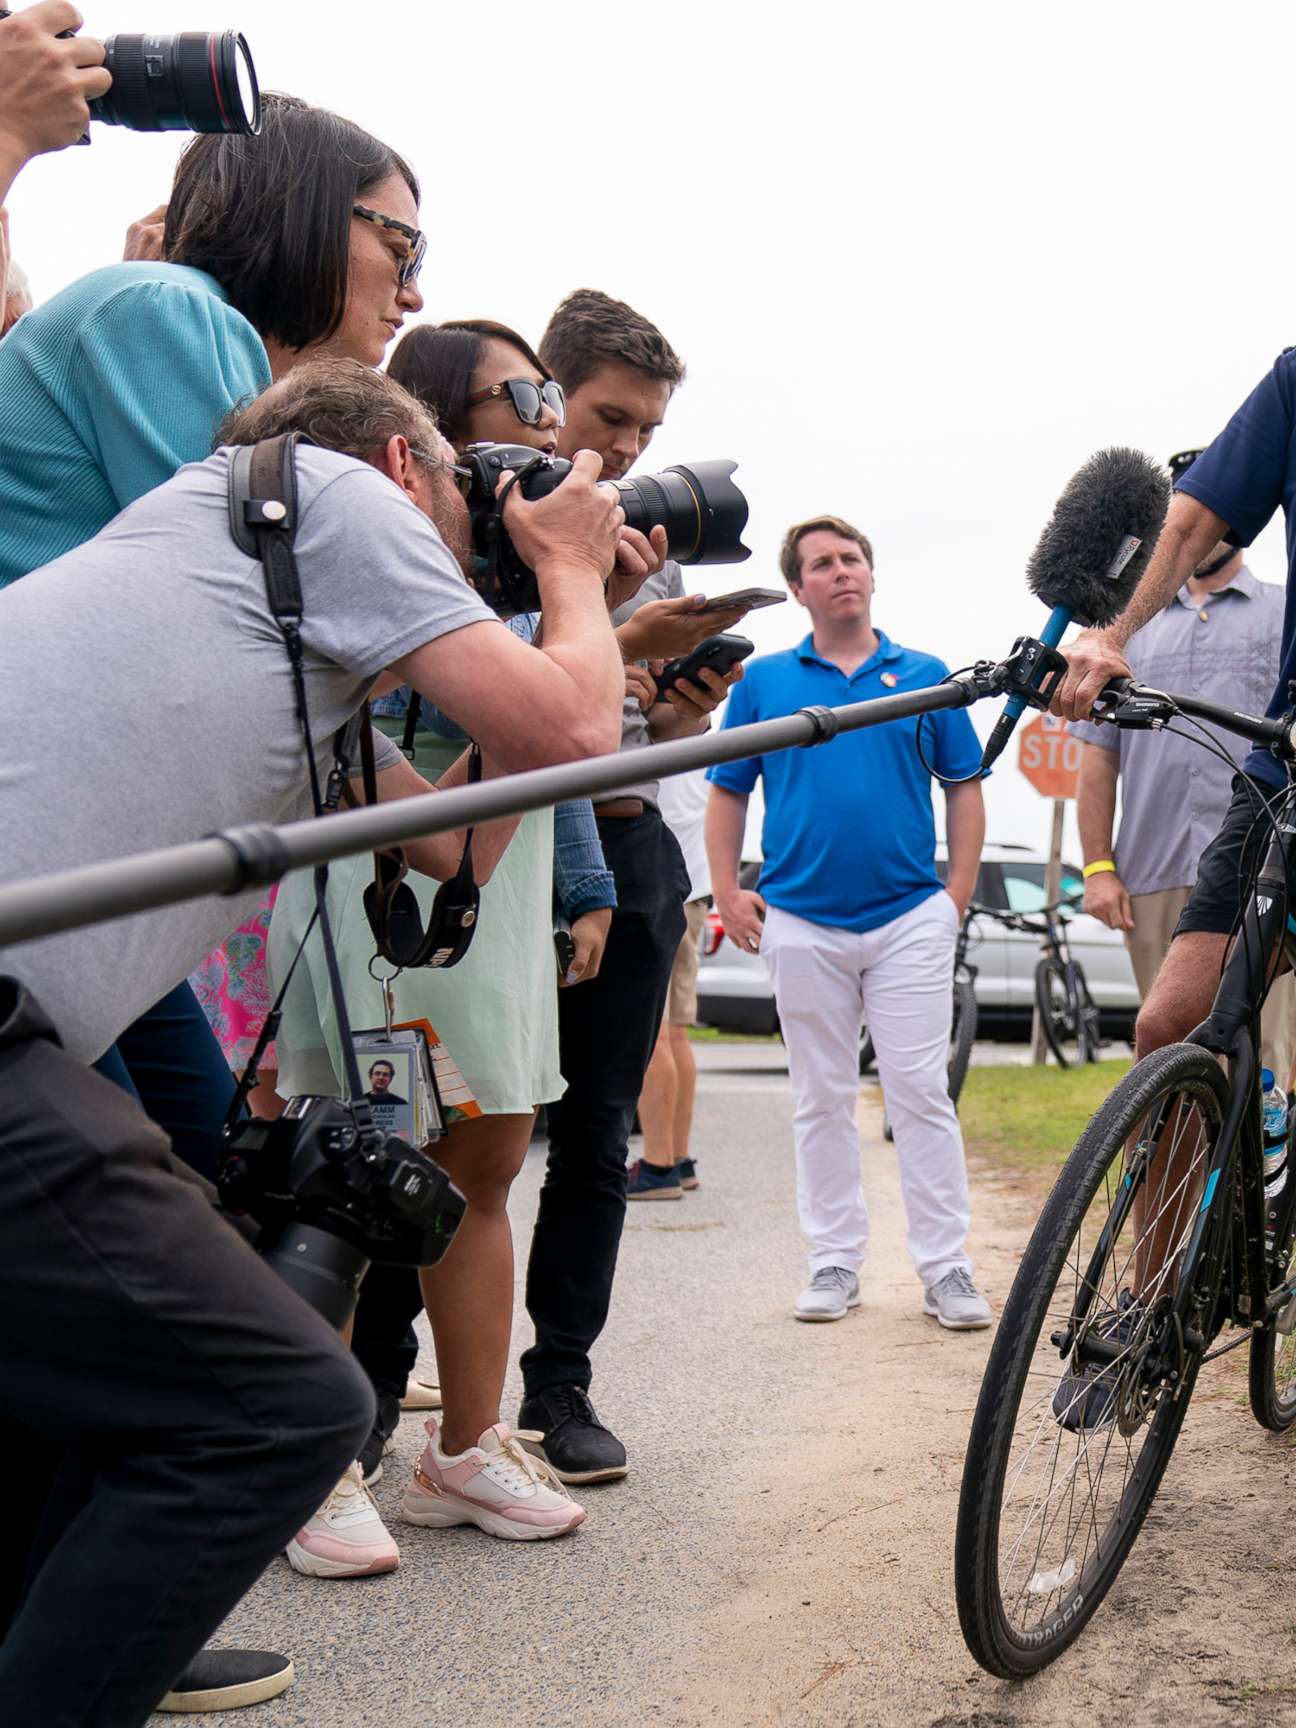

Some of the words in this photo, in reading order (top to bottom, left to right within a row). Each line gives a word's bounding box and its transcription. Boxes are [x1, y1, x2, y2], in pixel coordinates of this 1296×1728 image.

[1023, 732, 1084, 772] STO
[373, 1105, 396, 1113] AMM
[1010, 1593, 1085, 1647] TRAGER
